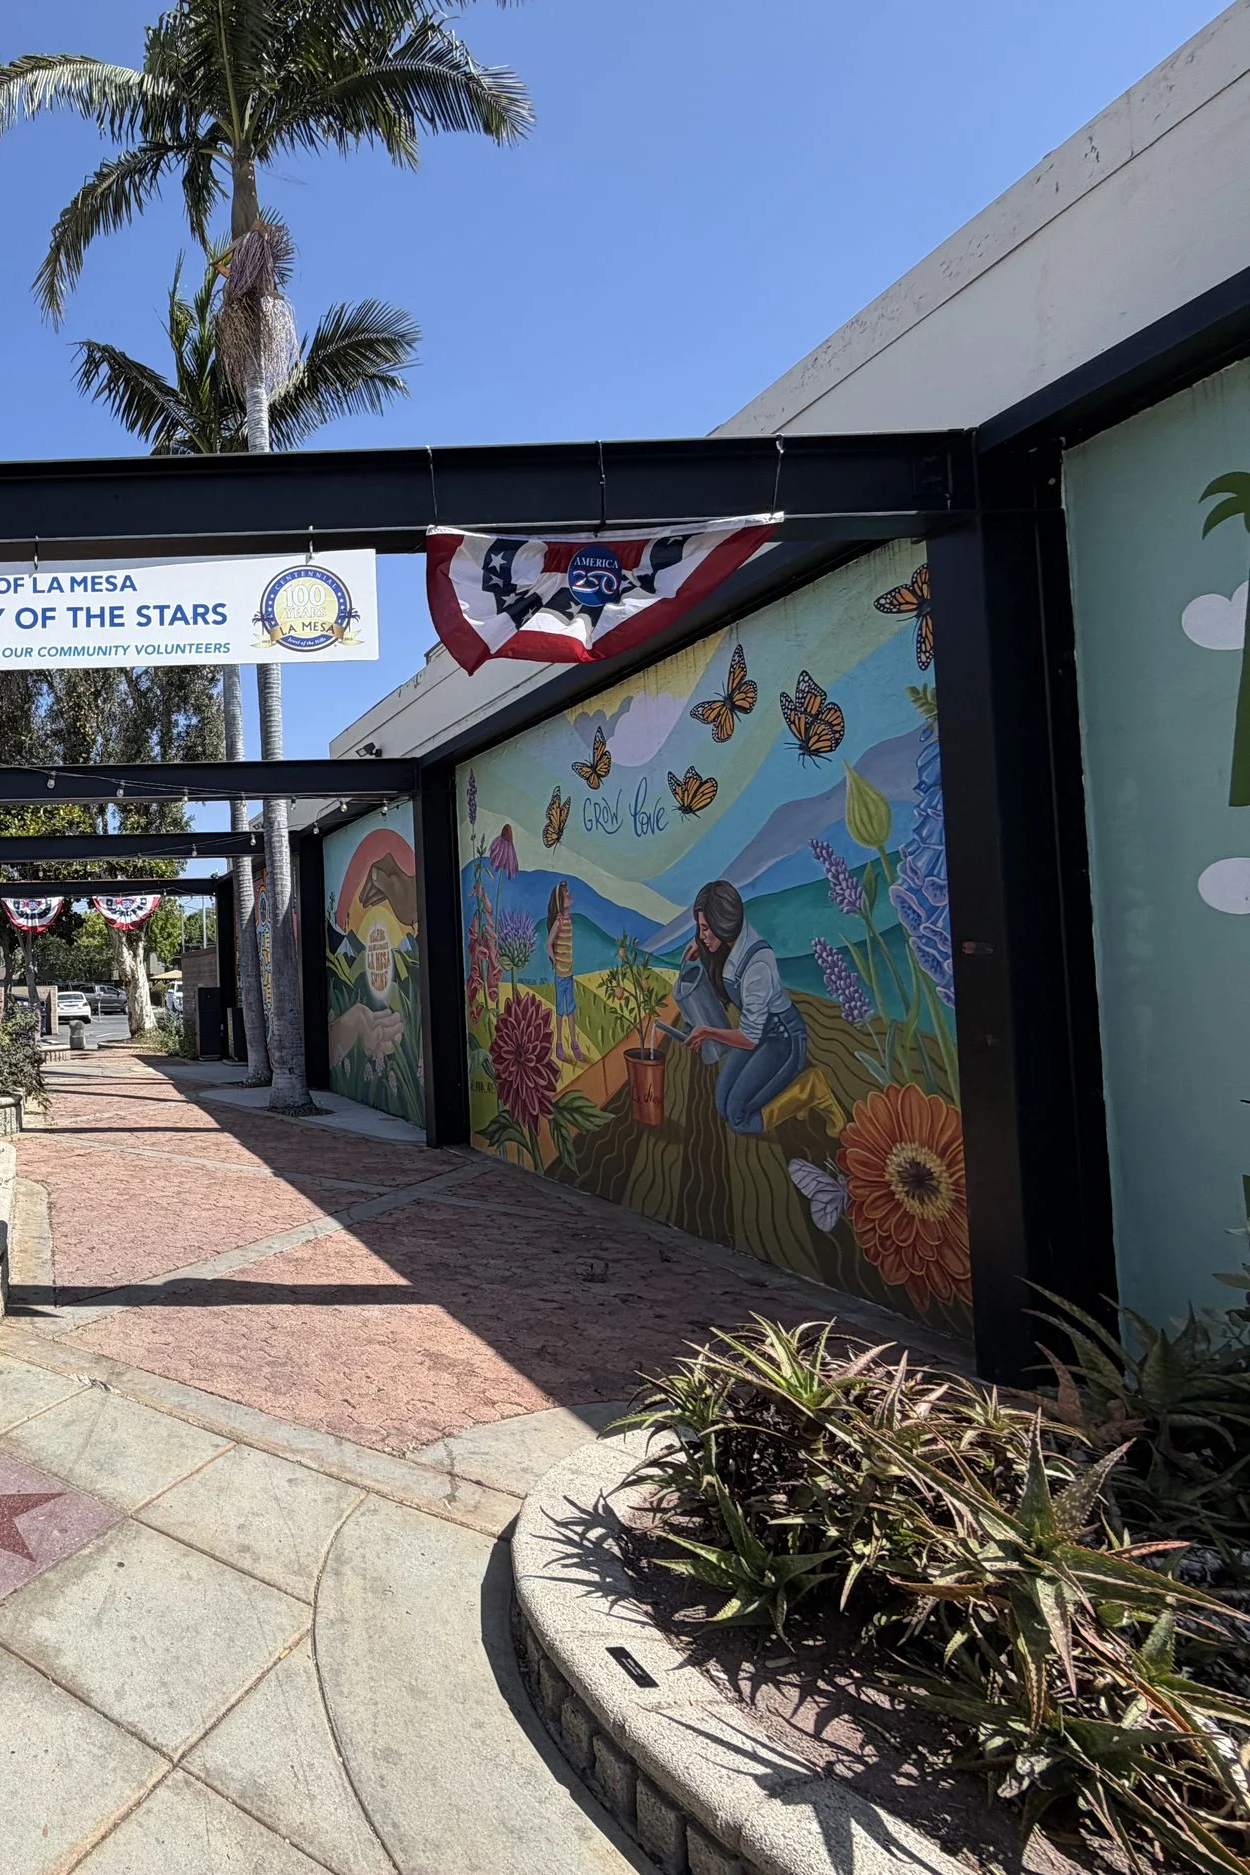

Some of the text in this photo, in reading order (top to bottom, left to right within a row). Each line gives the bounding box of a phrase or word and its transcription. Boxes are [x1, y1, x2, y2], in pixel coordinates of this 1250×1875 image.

[574, 557, 619, 569] AMERICA
[32, 576, 65, 594] LA
[70, 574, 138, 593] MESA
[275, 570, 337, 590] CENTENNIAL
[571, 570, 619, 594] 250
[284, 583, 327, 607] 100
[14, 606, 57, 630] OF
[66, 605, 125, 629] THE
[136, 602, 228, 628] STARS
[284, 606, 327, 619] YEARS
[279, 621, 335, 636] LA MESA
[1, 646, 34, 659] OUR
[37, 644, 131, 658] COMMUNITY
[134, 642, 231, 656] VOLUNTEERS
[583, 788, 623, 835] GROW
